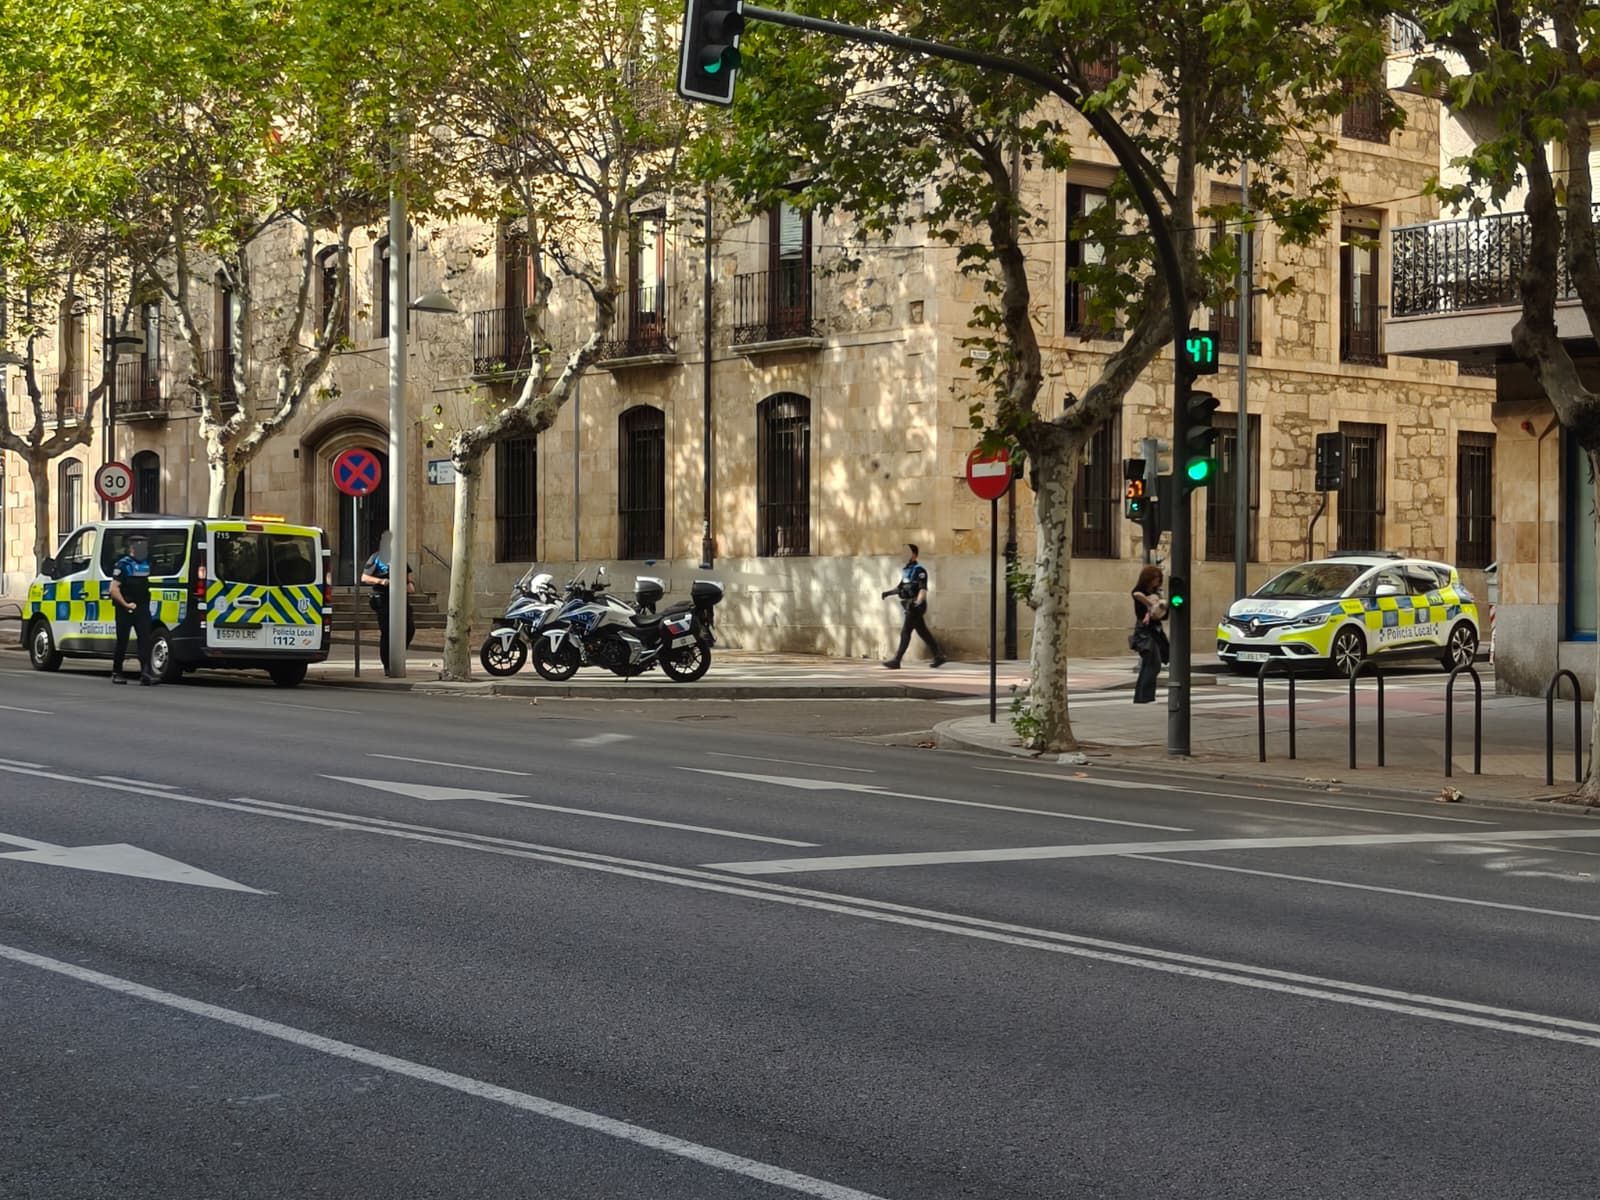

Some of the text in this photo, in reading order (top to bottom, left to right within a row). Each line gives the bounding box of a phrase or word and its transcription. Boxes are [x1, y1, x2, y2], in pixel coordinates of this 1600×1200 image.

[1186, 337, 1213, 363] 47
[104, 475, 126, 488] 30
[296, 628, 315, 637] Local
